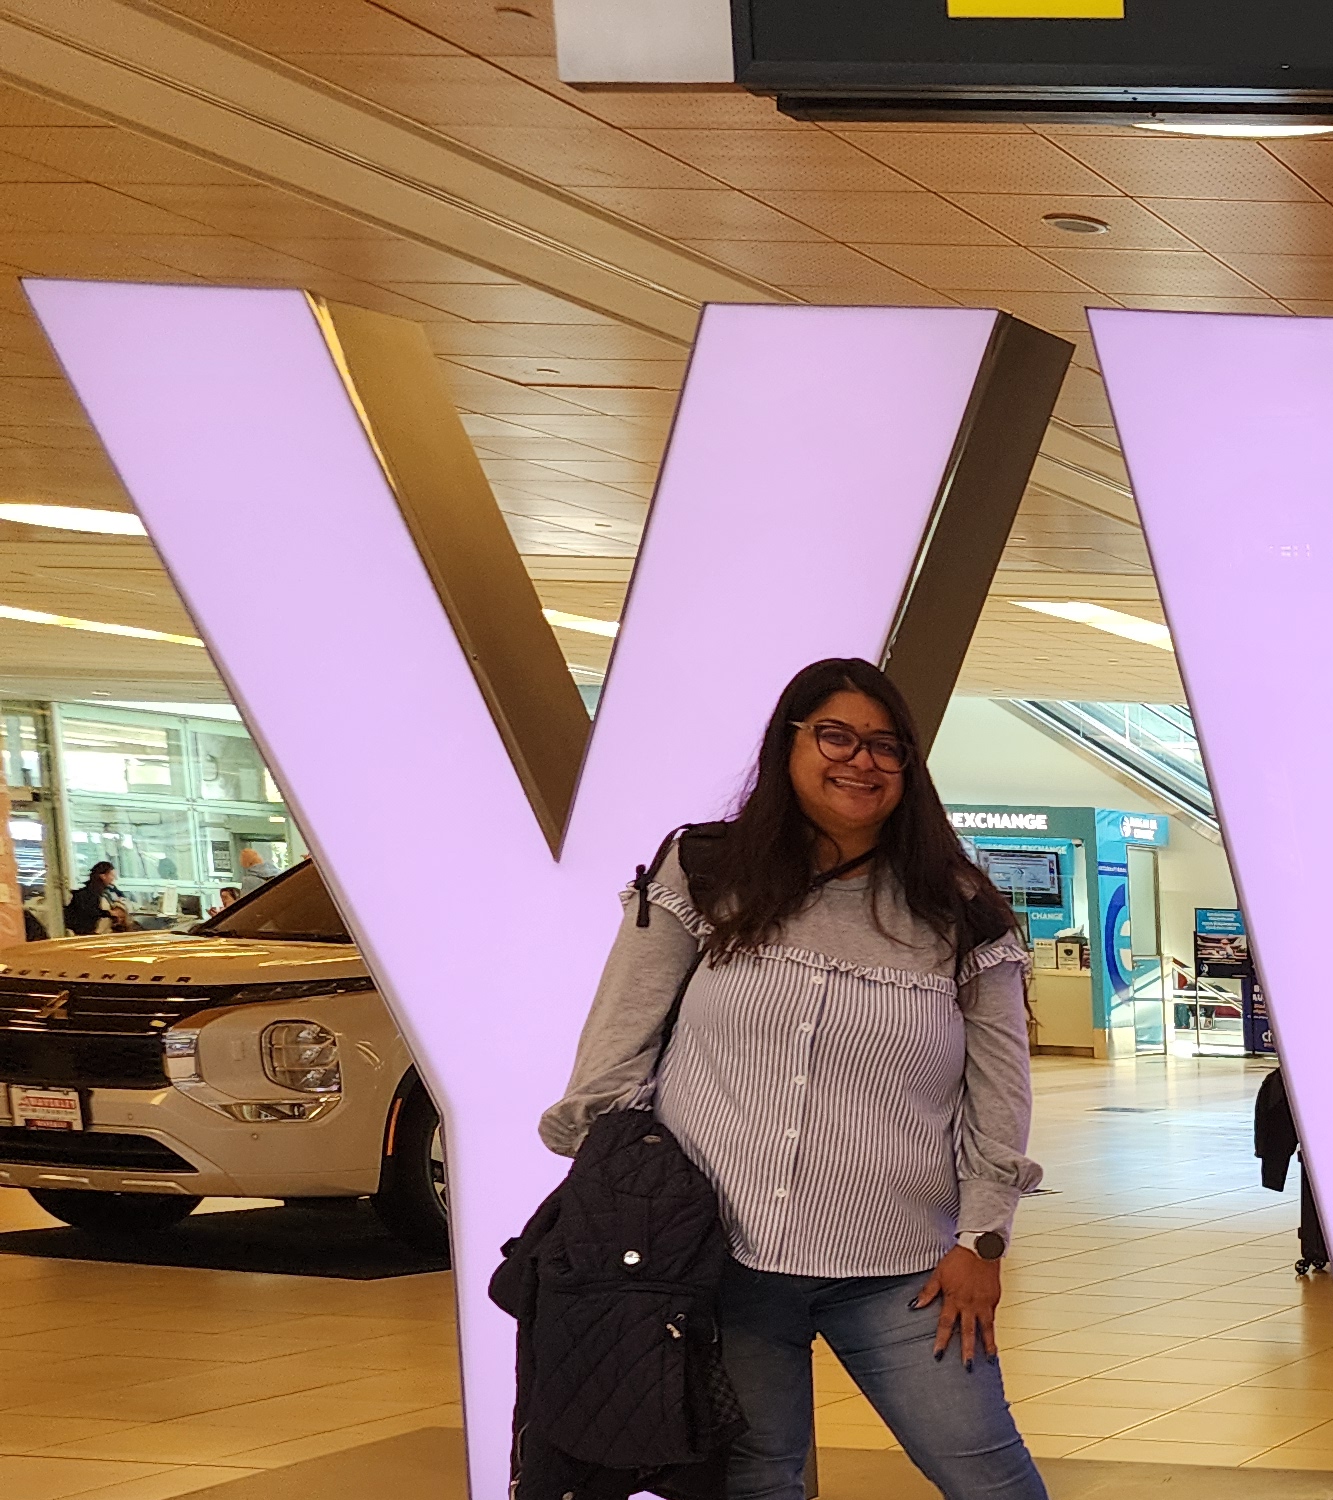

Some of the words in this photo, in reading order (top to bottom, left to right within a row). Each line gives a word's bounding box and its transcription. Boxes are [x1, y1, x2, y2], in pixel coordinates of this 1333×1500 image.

[952, 812, 1048, 831] EXCHANGE
[1031, 912, 1063, 921] CHANGE
[2, 968, 192, 983] OUTLANDER
